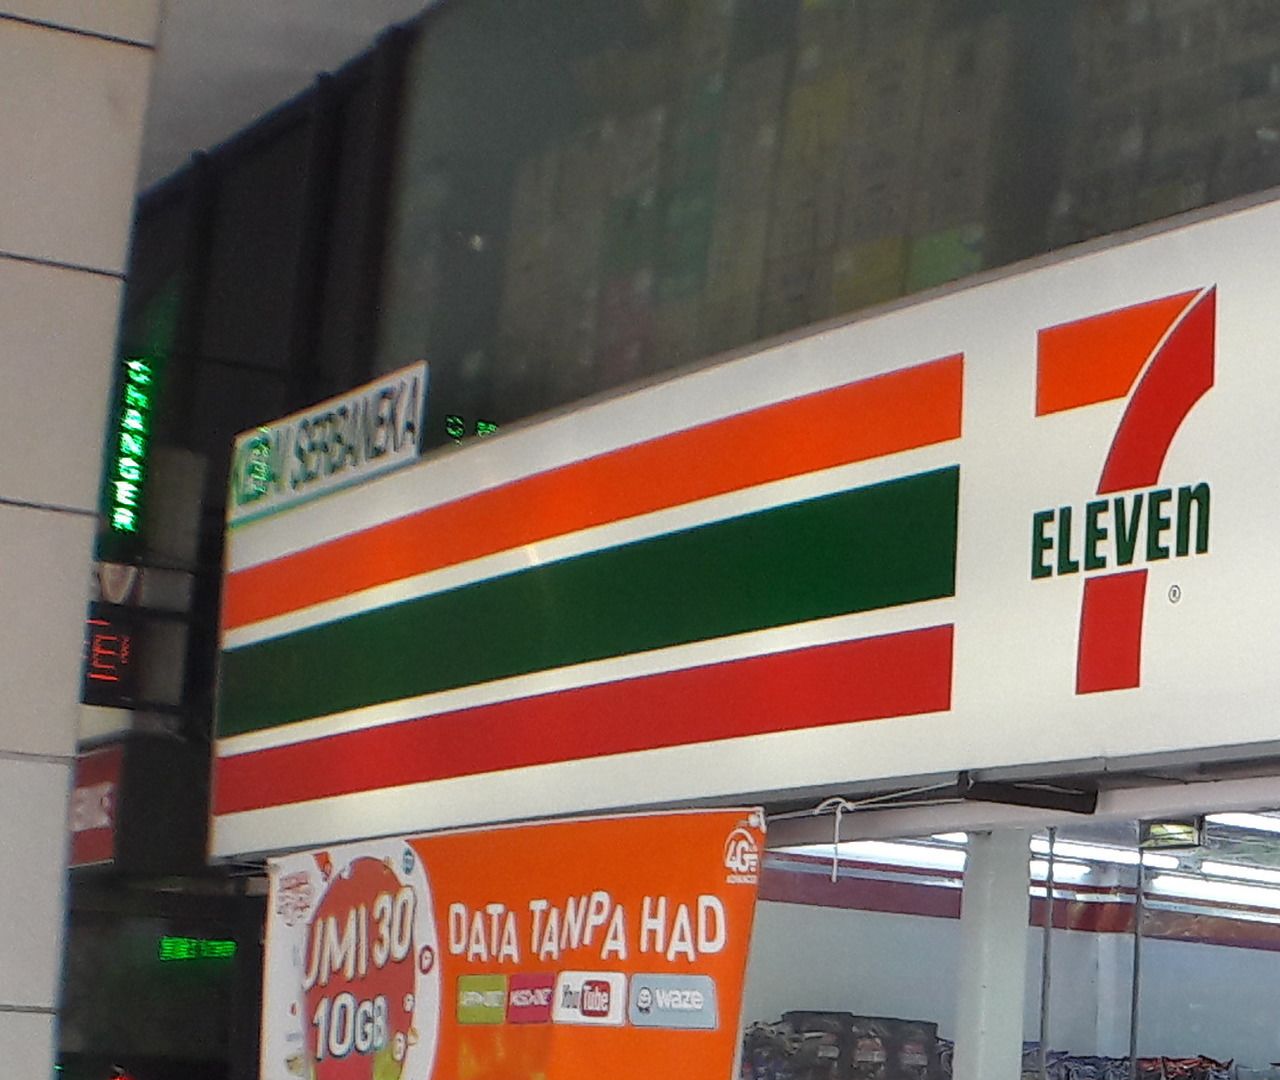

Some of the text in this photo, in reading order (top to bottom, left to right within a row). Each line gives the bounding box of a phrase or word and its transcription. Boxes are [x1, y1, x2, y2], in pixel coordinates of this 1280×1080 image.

[1034, 283, 1217, 695] 7
[372, 885, 416, 969] 30
[448, 890, 727, 964] DATA TANPA HAD
[312, 991, 388, 1062] 10GB
[656, 988, 704, 1010] waze
